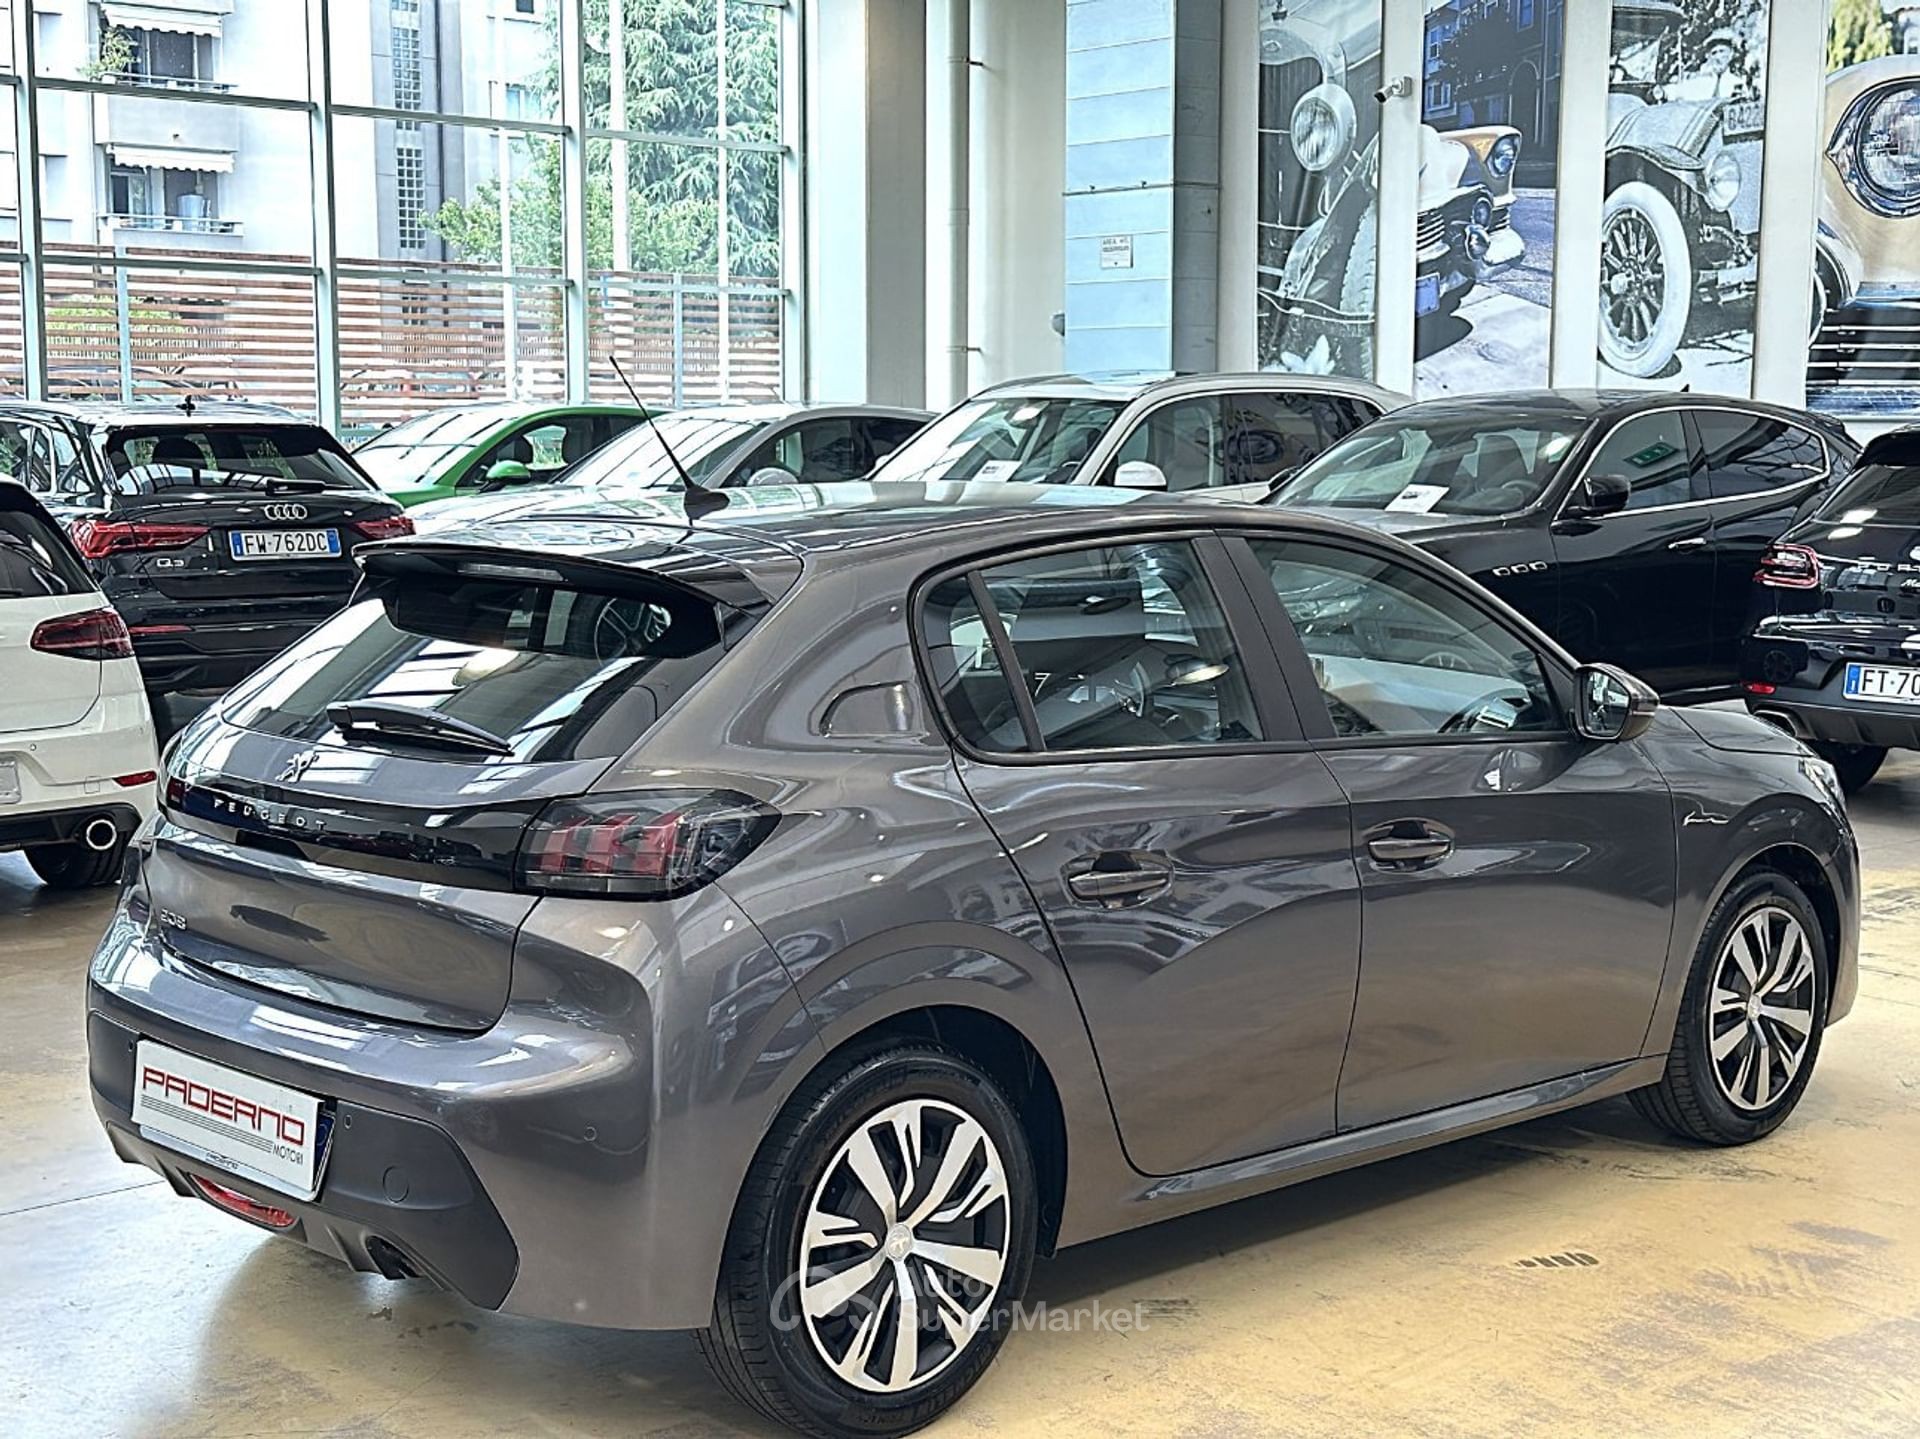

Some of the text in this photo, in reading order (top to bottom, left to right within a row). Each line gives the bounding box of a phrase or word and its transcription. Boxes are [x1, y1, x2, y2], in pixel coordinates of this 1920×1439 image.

[213, 798, 327, 831] PEUGEOT
[143, 1066, 305, 1146] PADERNO
[272, 1144, 304, 1166] MOTORI
